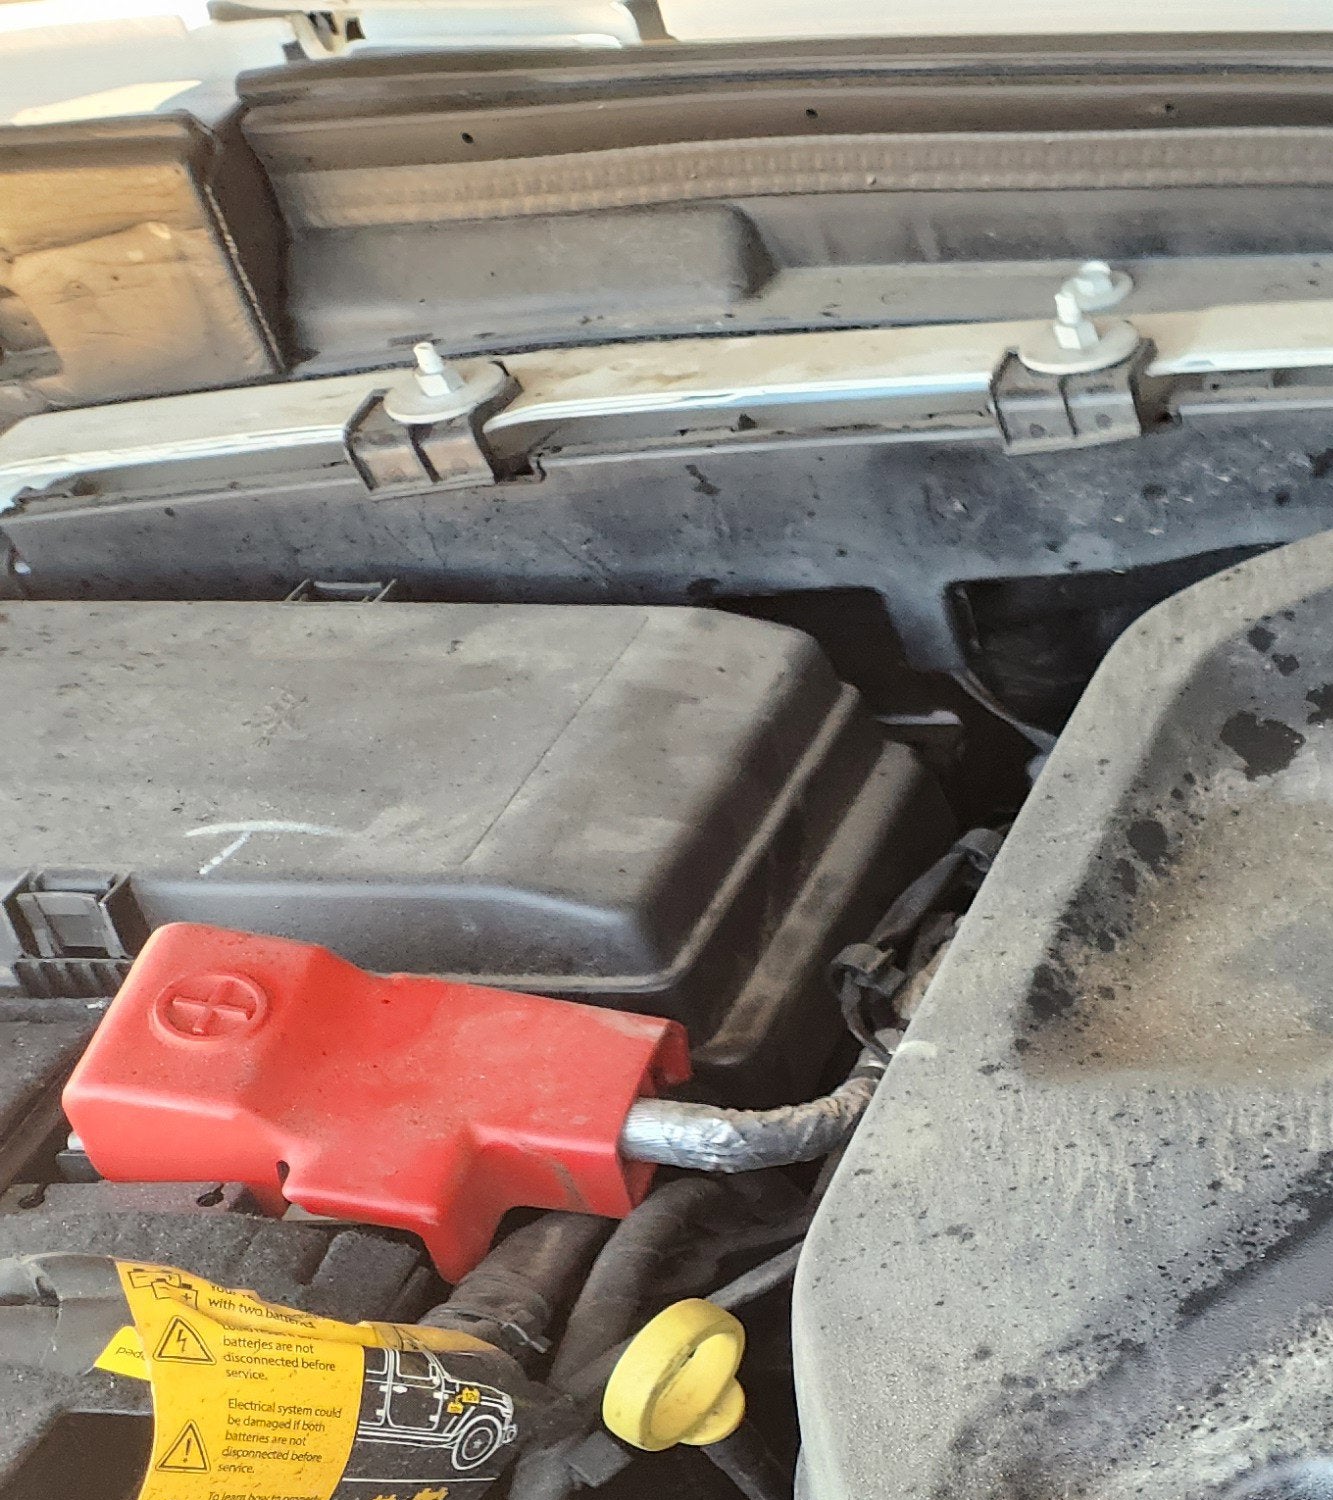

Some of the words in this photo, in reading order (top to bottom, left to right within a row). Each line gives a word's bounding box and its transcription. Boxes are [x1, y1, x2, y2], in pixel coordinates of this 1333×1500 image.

[208, 1298, 236, 1311] with
[239, 1303, 263, 1317] two
[223, 1335, 273, 1351] batteries
[275, 1342, 293, 1352] are
[295, 1343, 314, 1354] not
[223, 1352, 299, 1368] disconnected
[301, 1357, 336, 1372] before
[226, 1368, 268, 1381] service.
[228, 1398, 276, 1412] Electrical
[277, 1404, 313, 1417] system
[314, 1407, 342, 1418] could
[227, 1414, 241, 1426] be
[243, 1416, 291, 1430] damaged
[293, 1419, 302, 1430] if
[302, 1420, 326, 1432] both
[225, 1430, 269, 1443] batteries
[271, 1434, 288, 1444] are
[289, 1435, 307, 1446] not
[221, 1446, 289, 1461] disconnected
[290, 1450, 323, 1463] before
